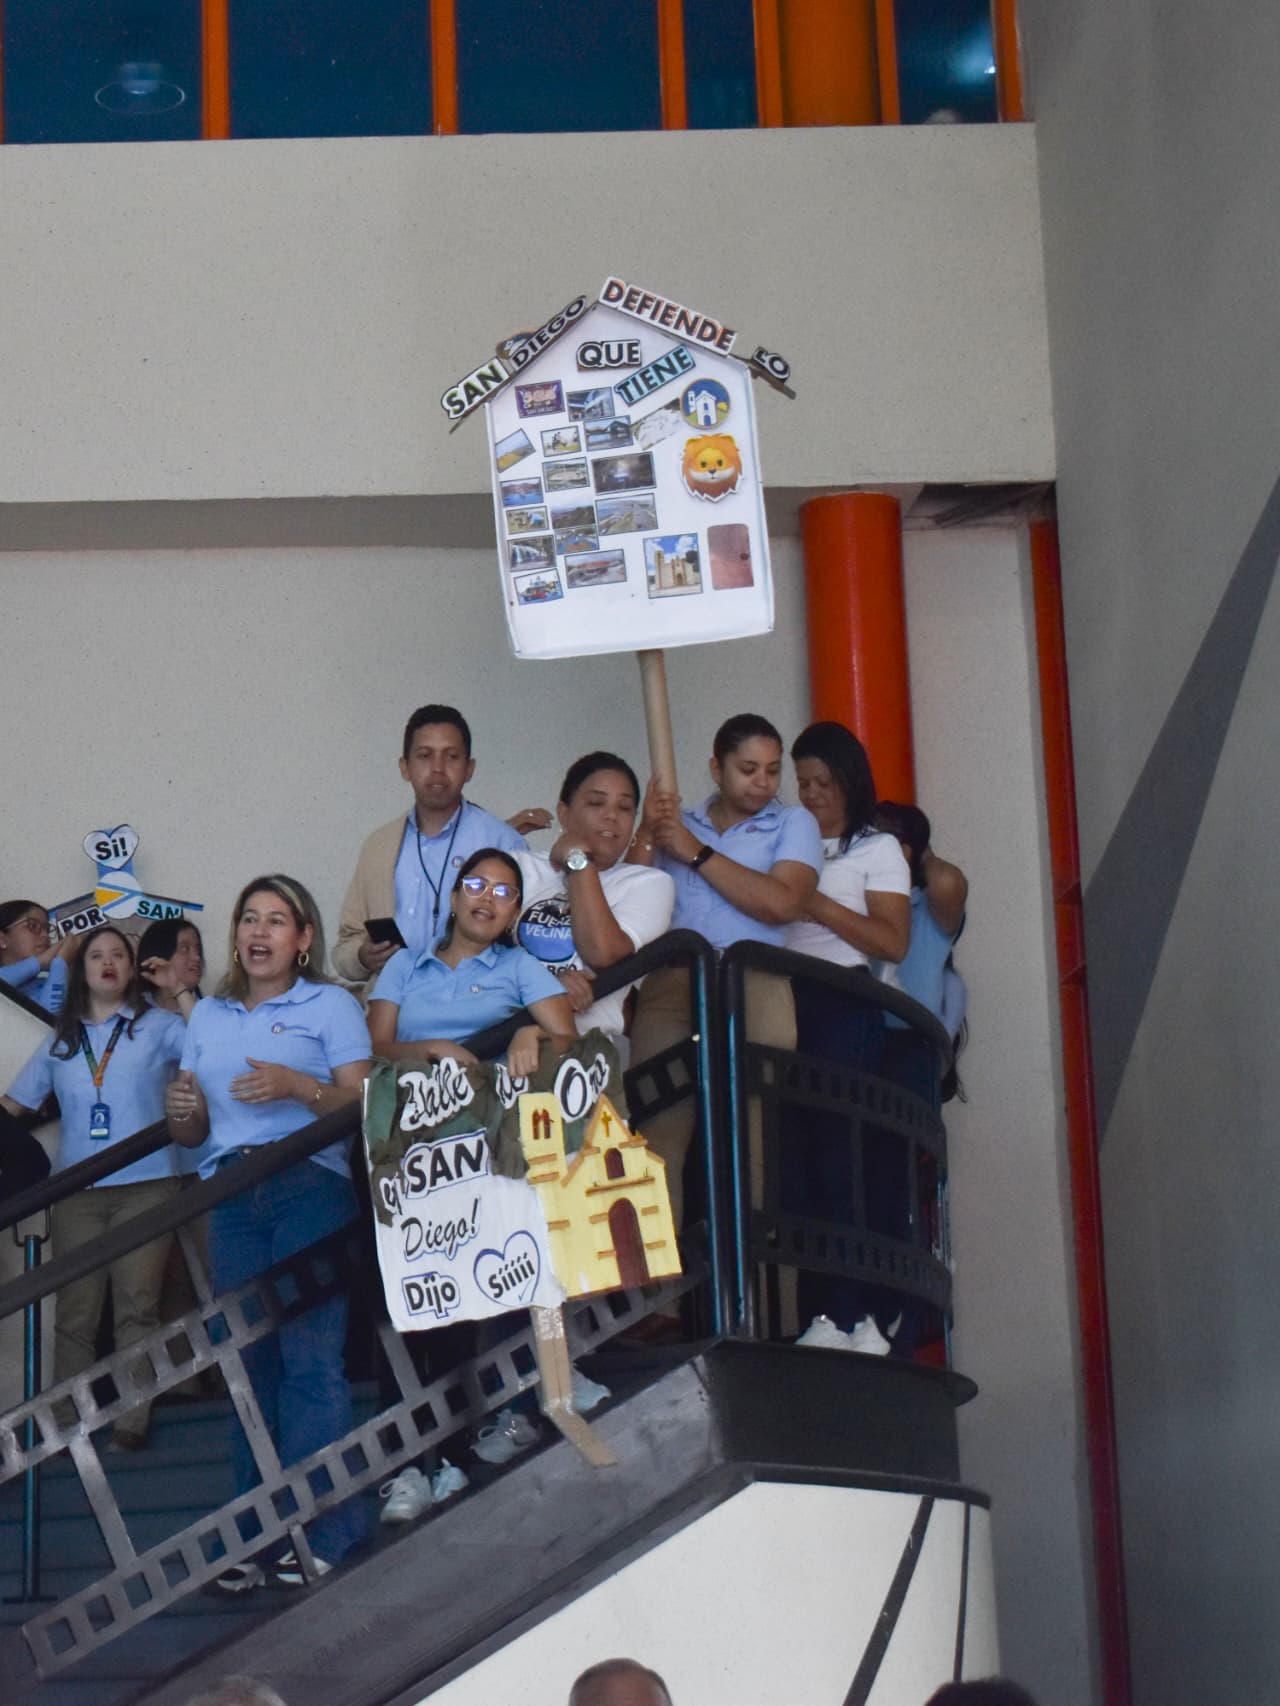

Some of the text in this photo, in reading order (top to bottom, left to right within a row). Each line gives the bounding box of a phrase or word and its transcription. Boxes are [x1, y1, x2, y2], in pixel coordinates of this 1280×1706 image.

[602, 278, 736, 351] DEFIENDE
[443, 297, 586, 416] SAN DIEGO
[578, 340, 640, 368] QUE
[616, 347, 693, 402] TIENE
[95, 836, 128, 860] Si!
[60, 908, 105, 933] POR
[137, 900, 180, 920] SAN
[528, 911, 572, 928] FUERZ
[406, 1142, 484, 1193] SAN
[401, 1197, 480, 1257] Diego!
[404, 1275, 456, 1314] Dijo
